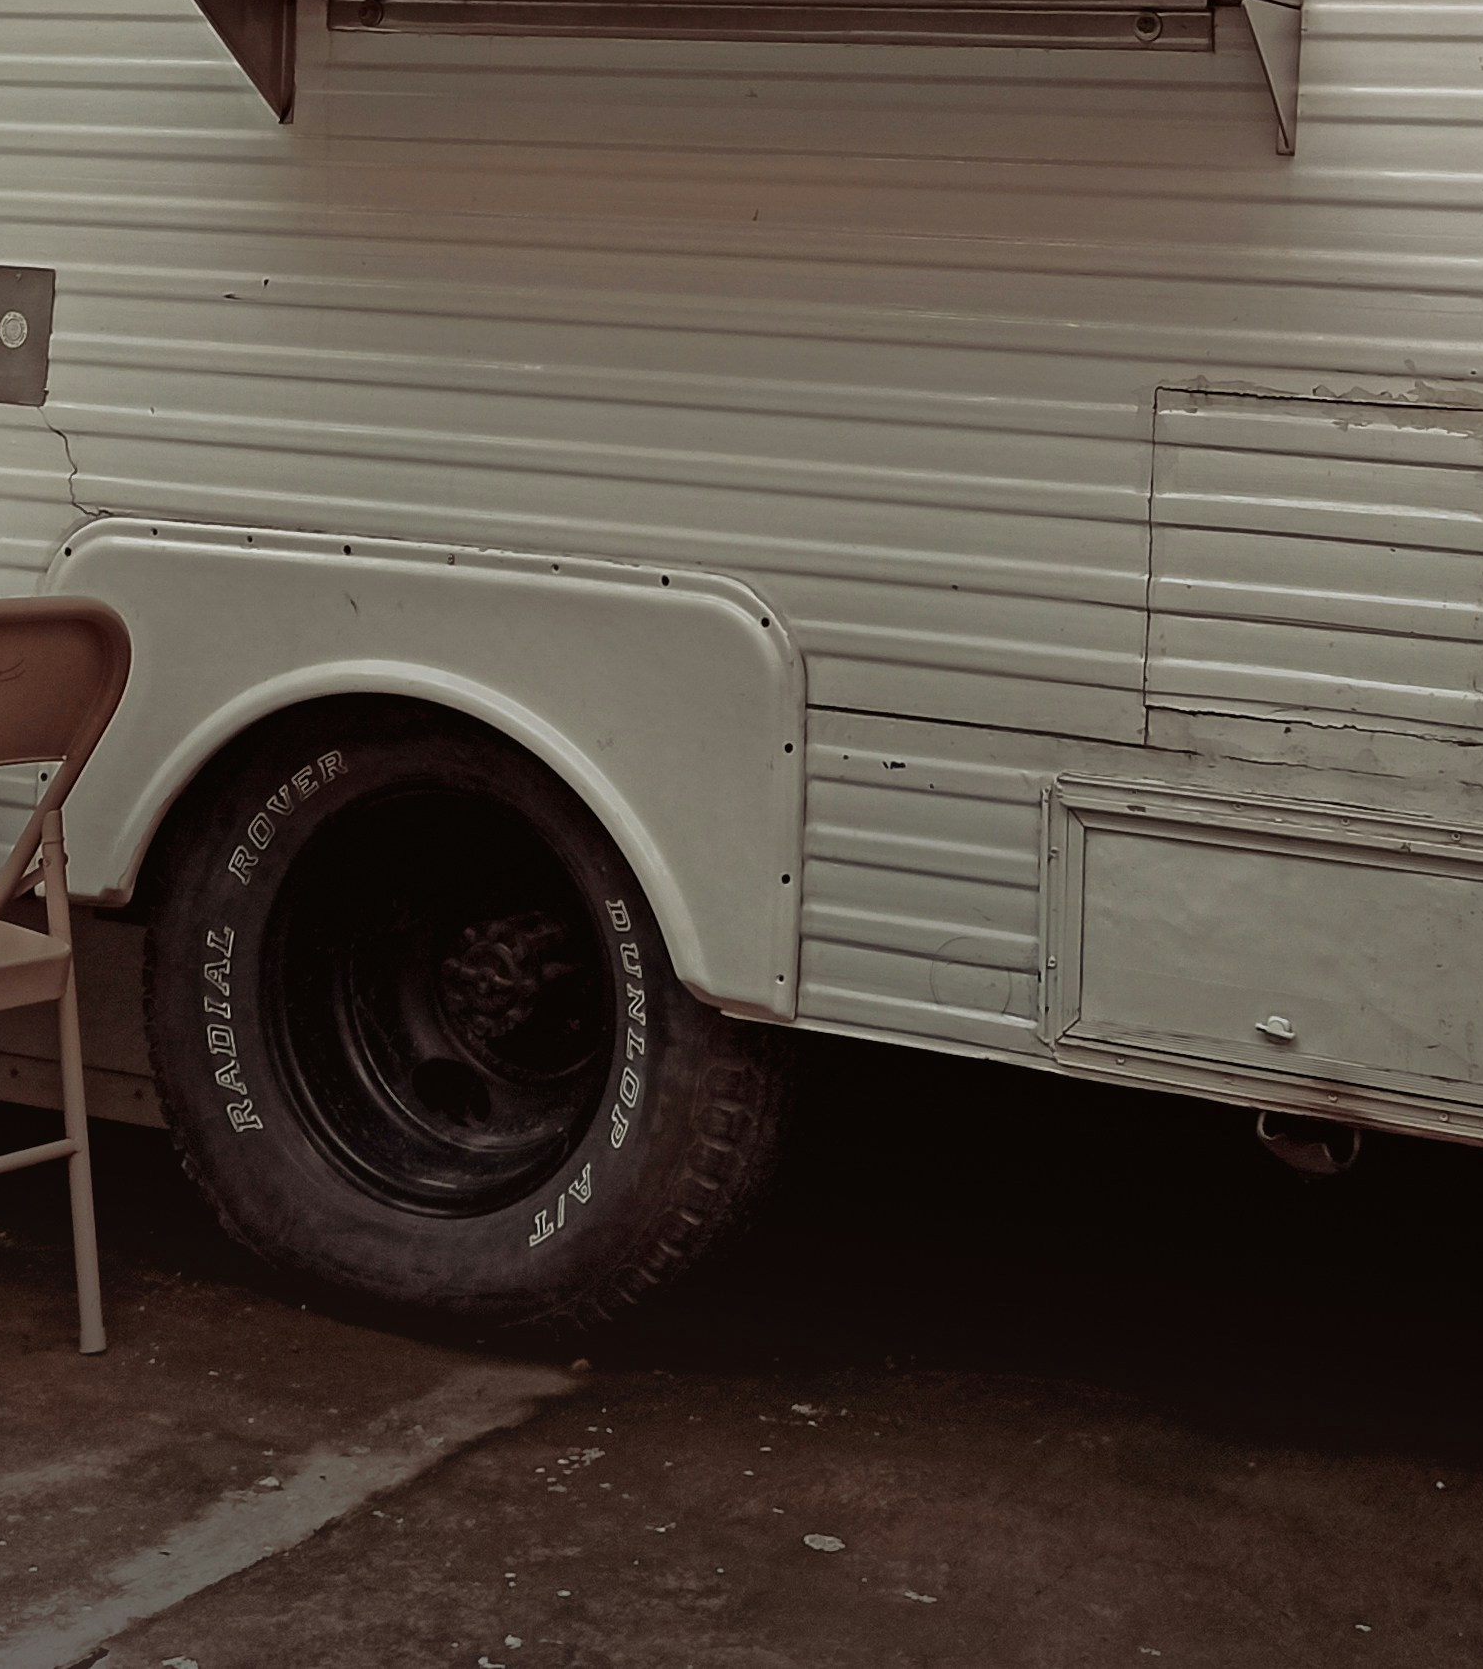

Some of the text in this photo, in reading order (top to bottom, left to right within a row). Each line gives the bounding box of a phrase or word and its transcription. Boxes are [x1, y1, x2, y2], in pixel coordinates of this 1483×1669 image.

[203, 749, 349, 1135] RADIAL ROVER
[528, 897, 649, 1248] DUNLOP A/T
